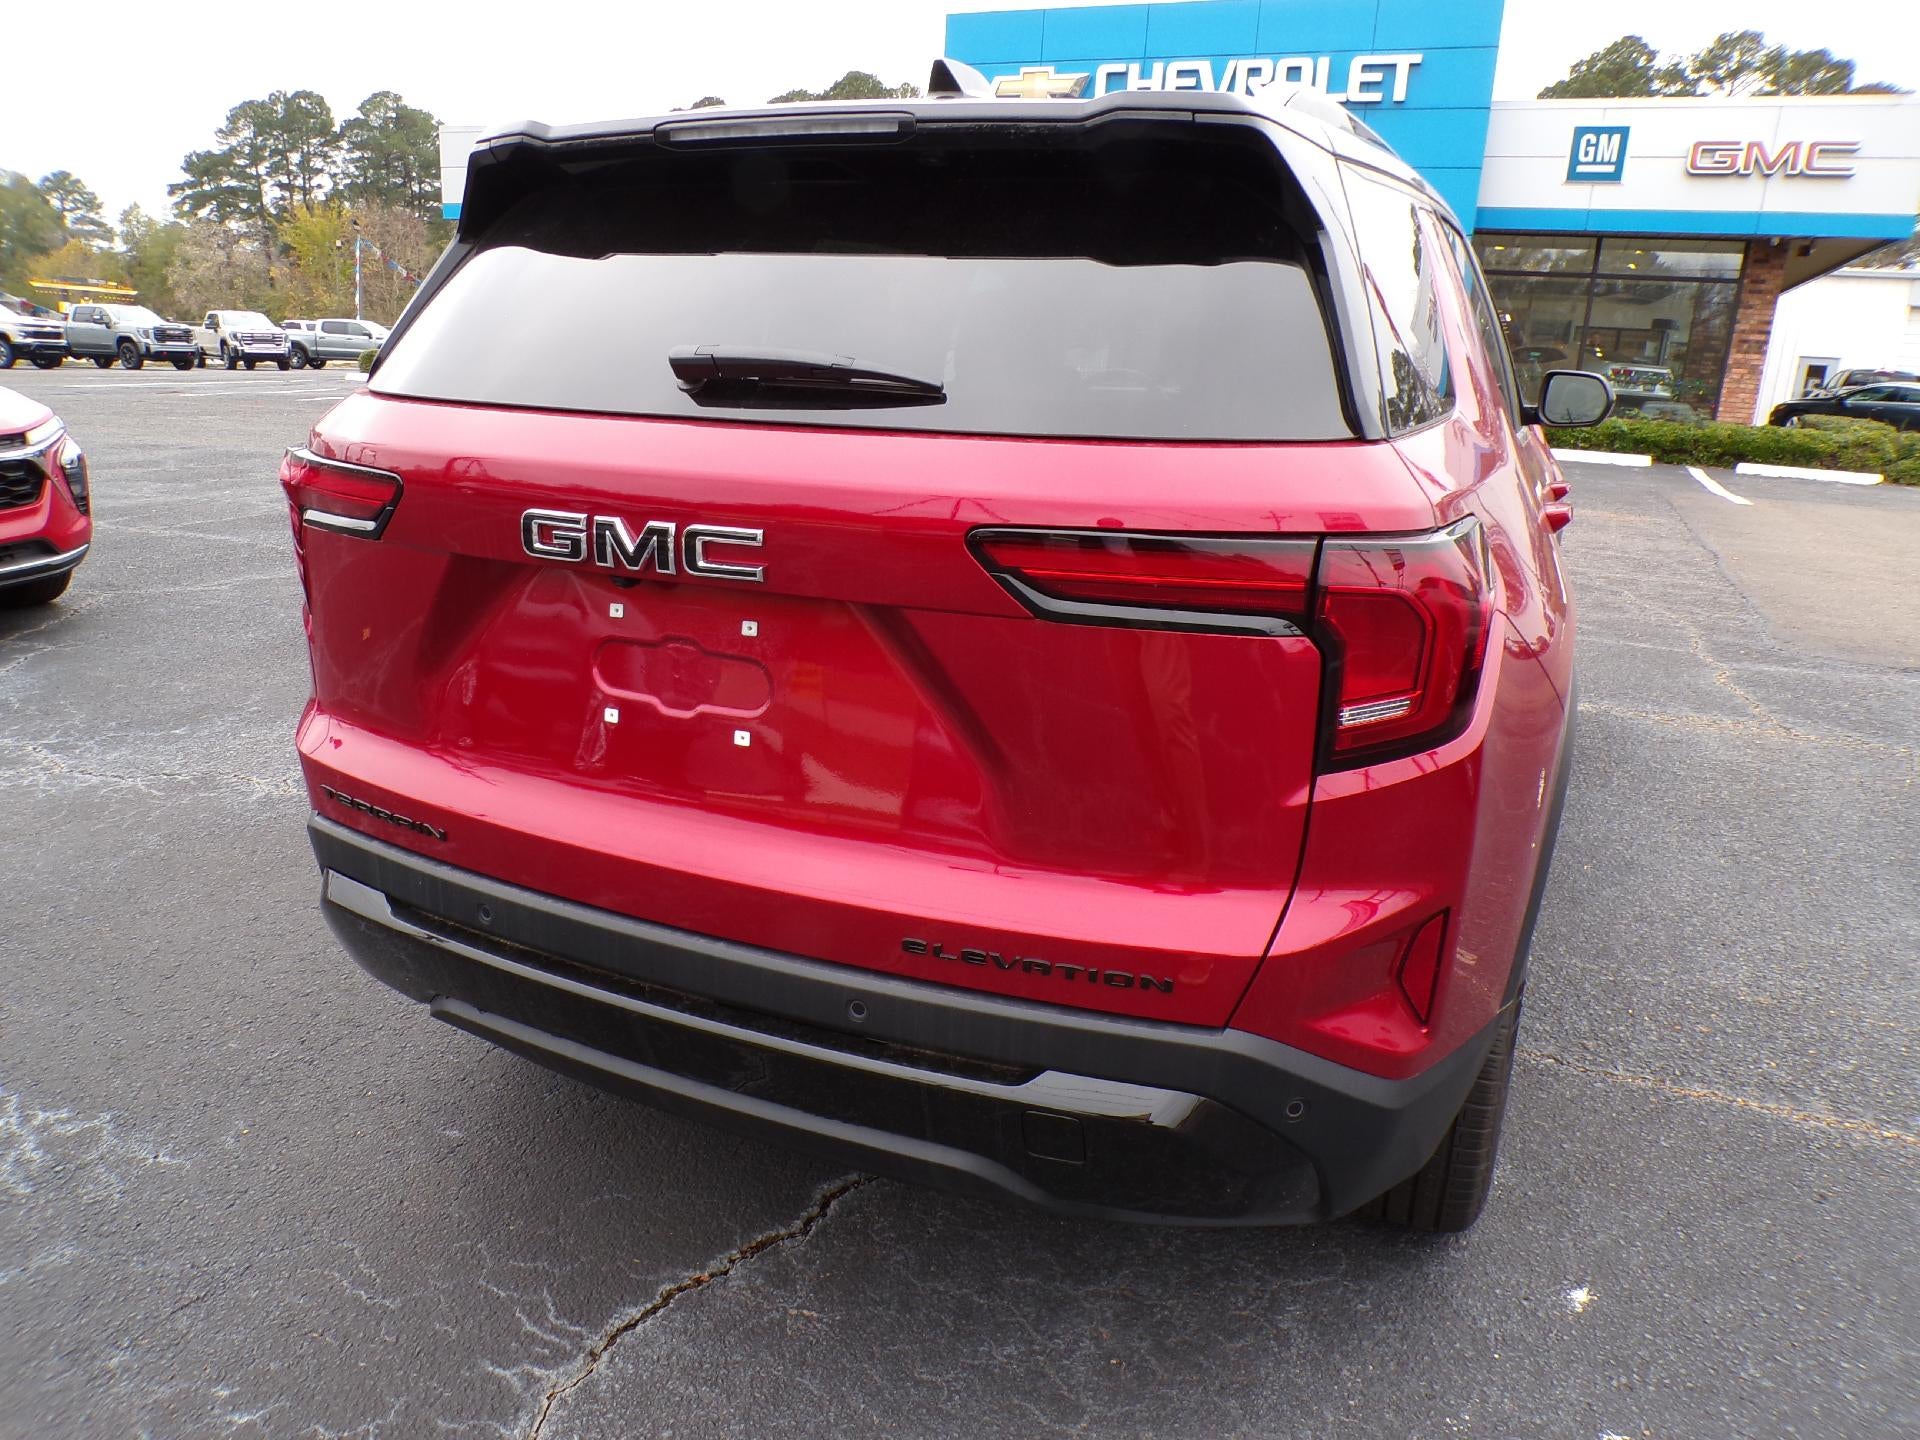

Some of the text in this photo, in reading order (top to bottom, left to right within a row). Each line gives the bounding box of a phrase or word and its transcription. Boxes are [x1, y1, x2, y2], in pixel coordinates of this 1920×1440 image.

[1094, 53, 1423, 103] CHEVROLET
[1578, 133, 1622, 163] GM
[1686, 140, 1863, 178] GMC
[521, 508, 764, 582] GMC
[320, 784, 447, 842] TERRAIN
[901, 937, 1174, 993] ELEVATION
